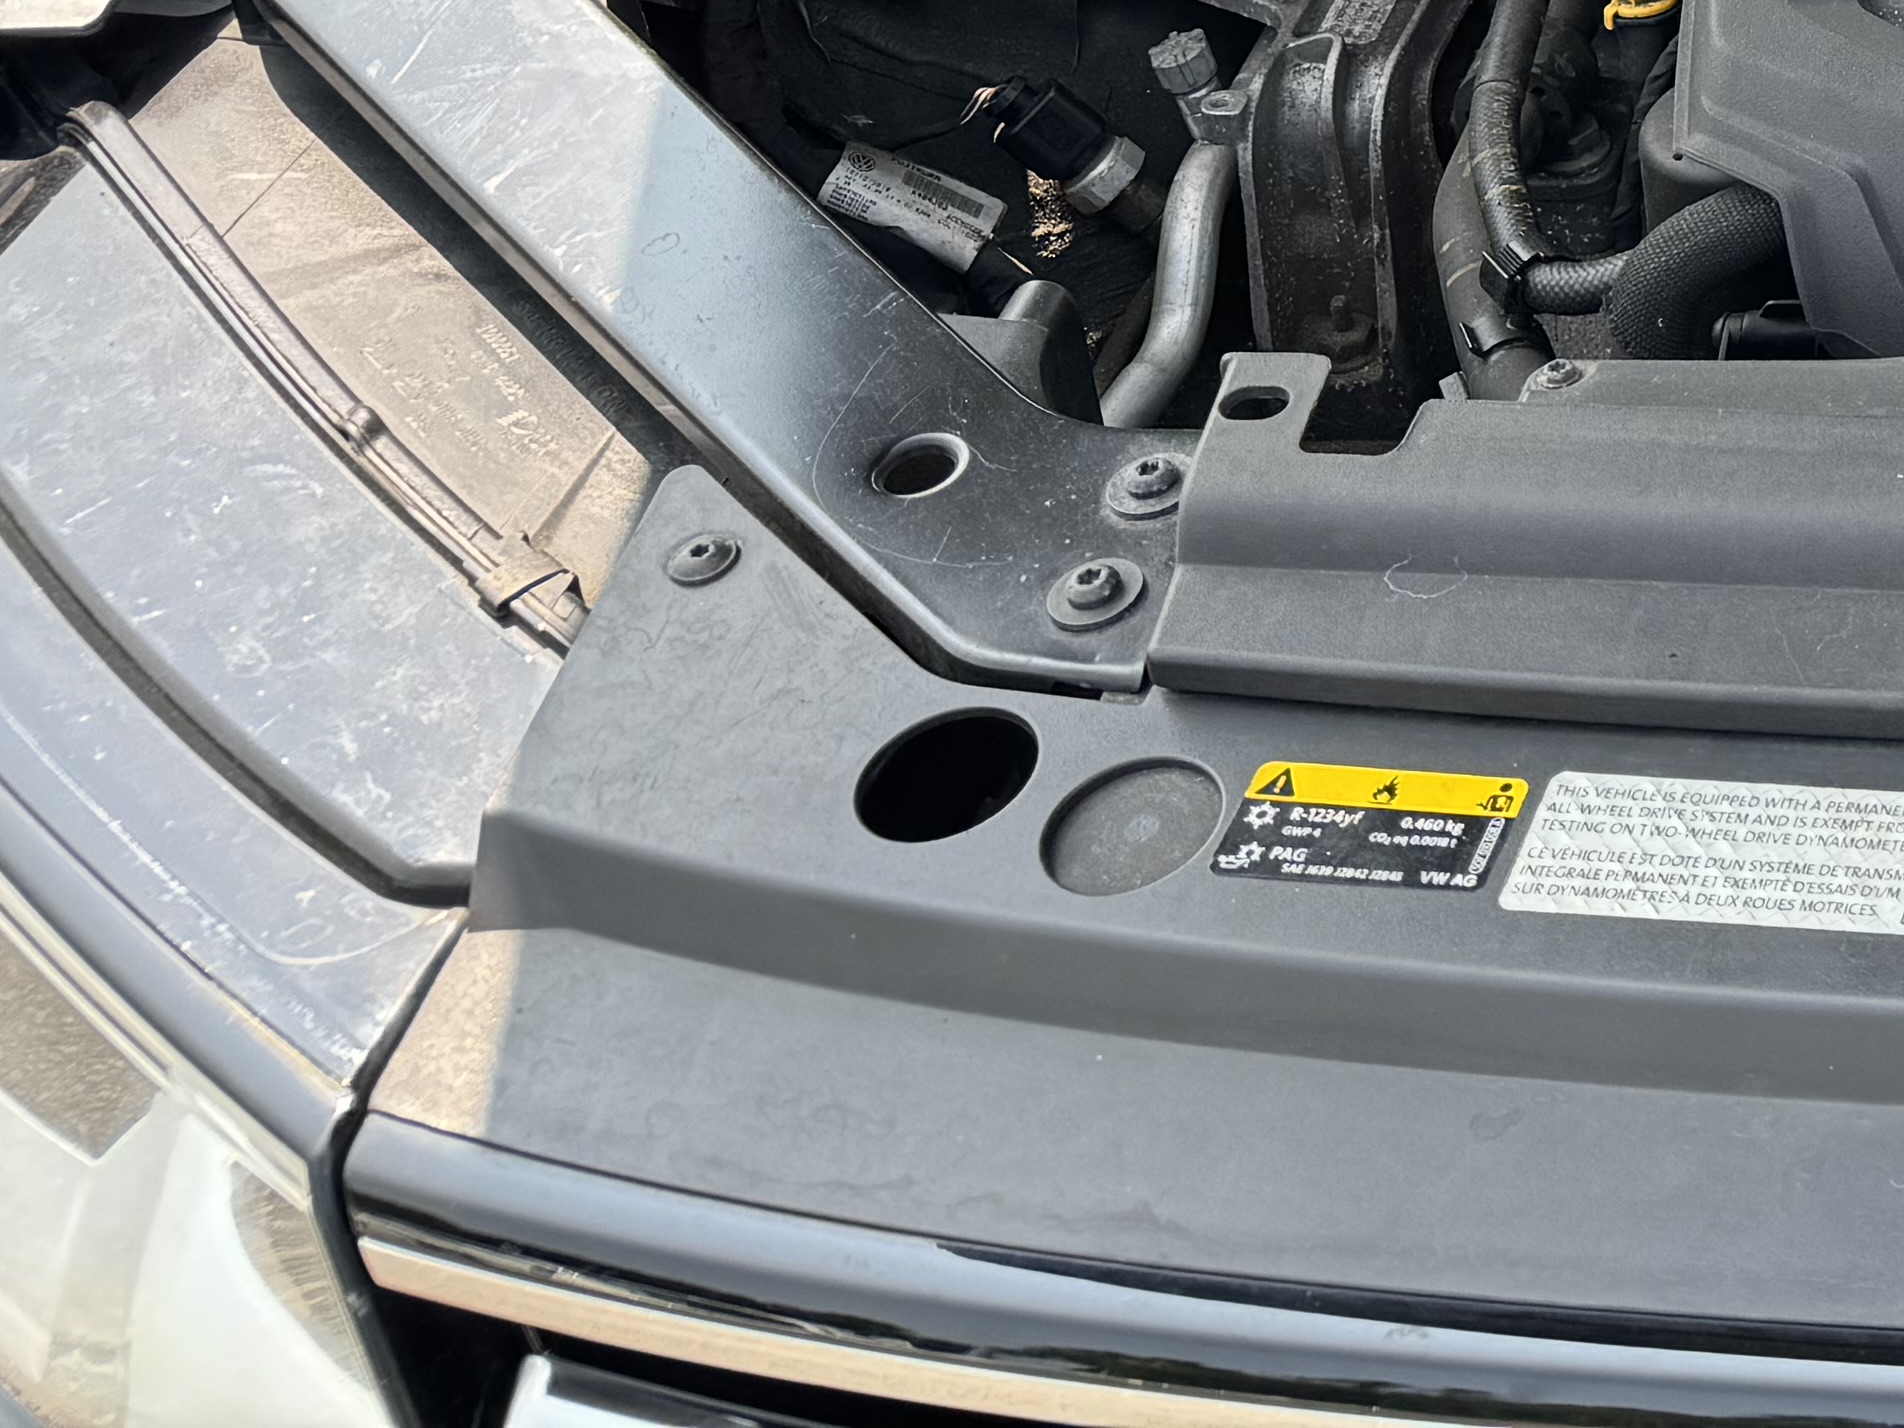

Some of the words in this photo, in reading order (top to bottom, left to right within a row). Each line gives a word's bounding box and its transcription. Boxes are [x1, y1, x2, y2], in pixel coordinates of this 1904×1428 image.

[1556, 784, 1590, 798] THIS
[1595, 786, 1658, 803] VEHICLE
[1661, 791, 1676, 802] IS
[1679, 793, 1760, 808] EQUIPPED
[1765, 797, 1808, 811] WITH
[1810, 800, 1821, 812] A
[1289, 807, 1365, 828] R-1234yf
[1400, 816, 1443, 831] 0.460
[1445, 819, 1464, 836] kg
[1540, 819, 1606, 834] TESTING
[1610, 822, 1635, 835] ON
[1743, 830, 1792, 845] DRIVE
[1639, 807, 1685, 821] DRIVE
[1690, 811, 1749, 825] SYSTEM
[1753, 815, 1790, 828] AND
[1793, 816, 1807, 828] IS
[1811, 818, 1874, 833] EXEMPT
[1282, 826, 1310, 837] GWP
[1311, 828, 1322, 838] 4
[1410, 835, 1448, 847] 0.0018
[1269, 846, 1308, 862] PAG
[1527, 847, 1546, 859] CE
[1550, 845, 1627, 864] VÉHICULE
[1629, 853, 1655, 864] EST
[1704, 857, 1745, 871] D'UN
[1748, 859, 1815, 876] SYSTÈME
[1818, 863, 1839, 876] DE
[1281, 863, 1306, 874] SAE
[1421, 871, 1451, 887] VW
[1450, 874, 1478, 888] AG
[1605, 870, 1698, 887] PERMANENT
[1701, 875, 1718, 888] ET
[1721, 876, 1791, 893] EXEMPTÉ
[1792, 880, 1857, 895] D'ESSAIS
[1860, 885, 1902, 900] D'I/M
[1511, 882, 1544, 894] SUR
[1678, 891, 1691, 904] À
[1695, 894, 1740, 908] DEUX
[1743, 897, 1796, 911] ROUES
[1799, 900, 1879, 918] MOTRICES
